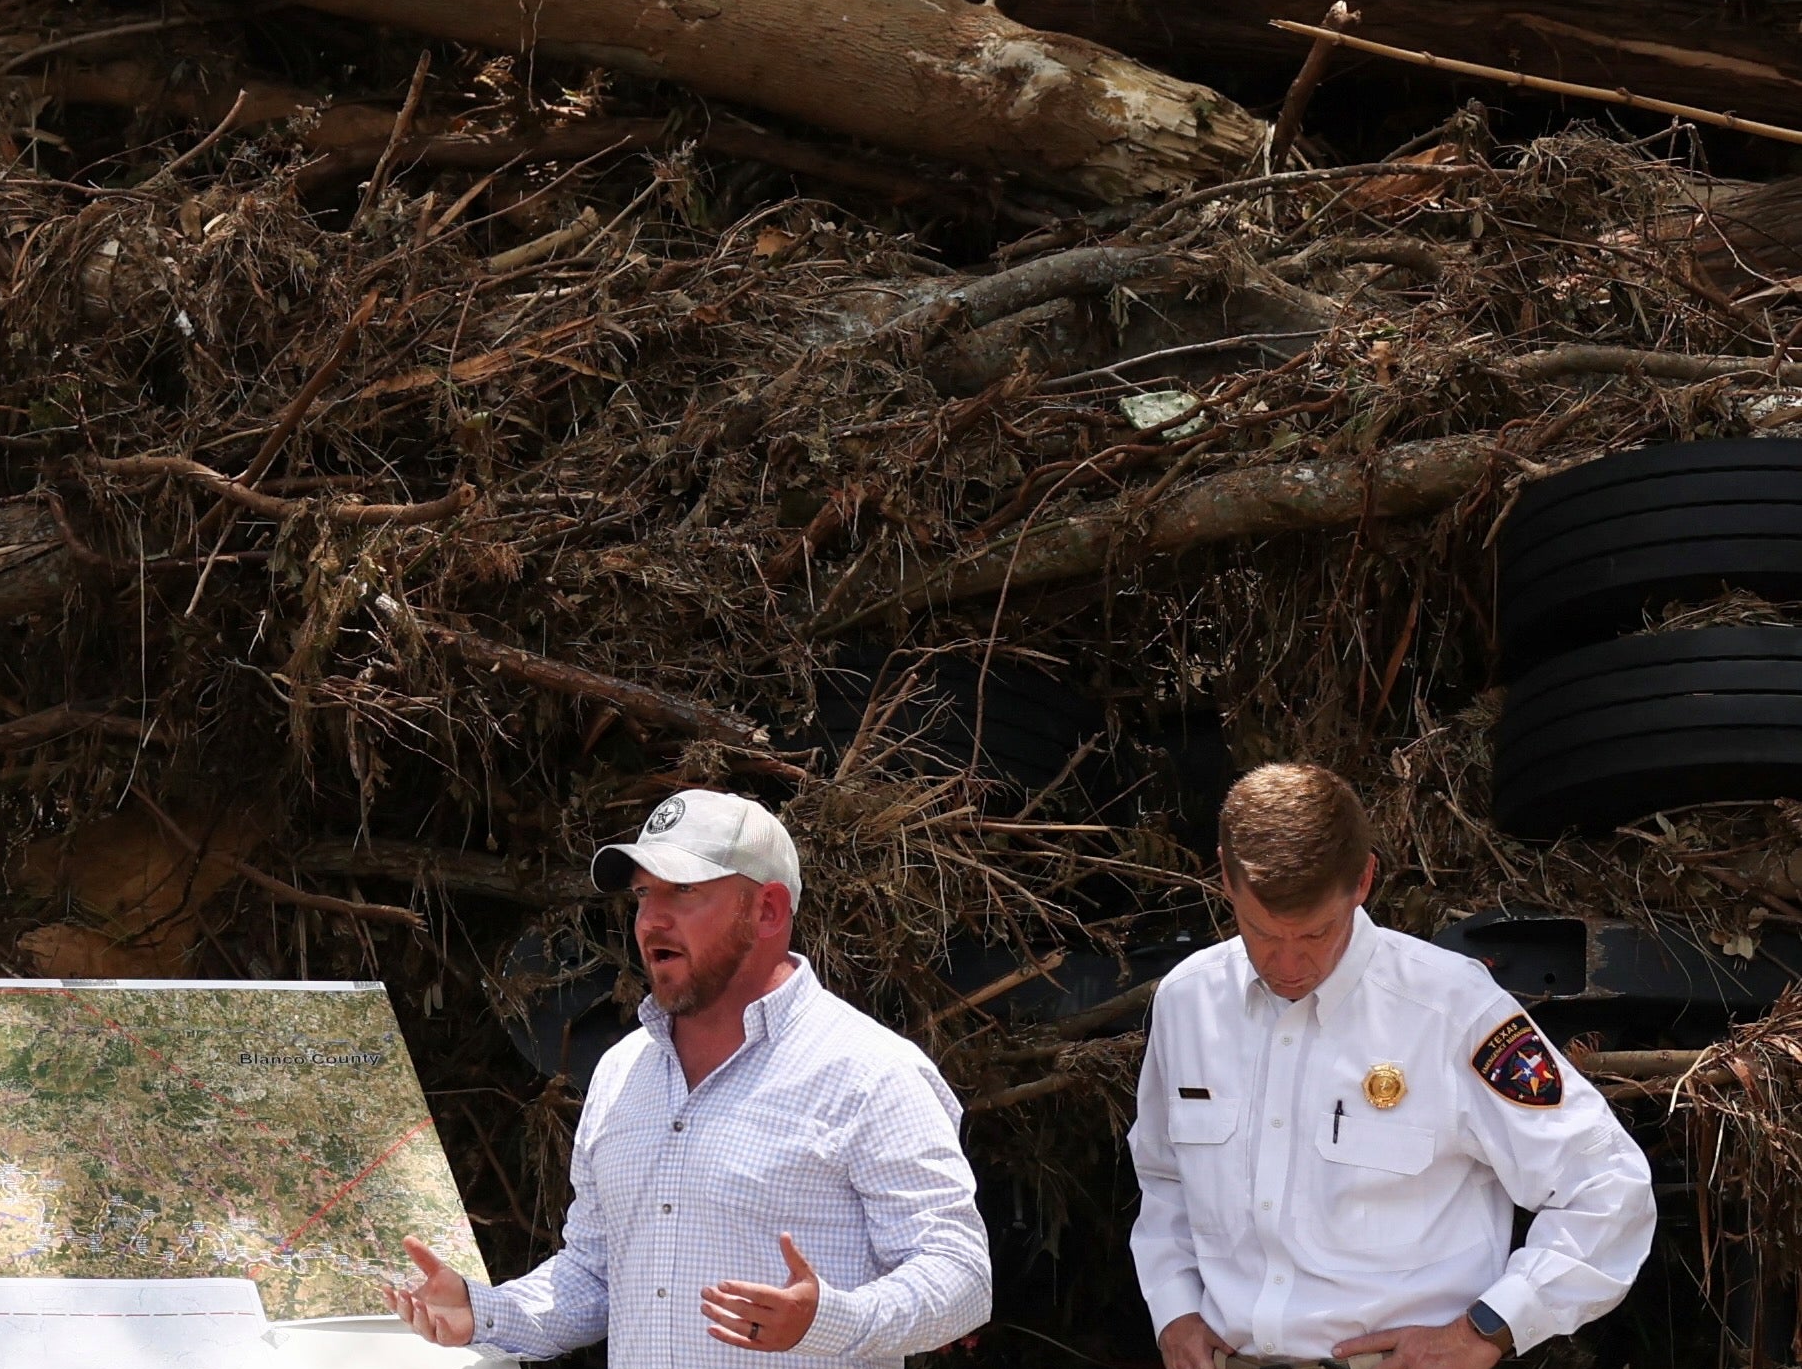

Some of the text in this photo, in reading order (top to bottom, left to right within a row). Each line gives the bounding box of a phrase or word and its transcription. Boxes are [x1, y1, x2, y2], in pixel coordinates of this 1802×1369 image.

[1488, 1023, 1518, 1048] TEXAS
[239, 1052, 380, 1066] Blanco County
